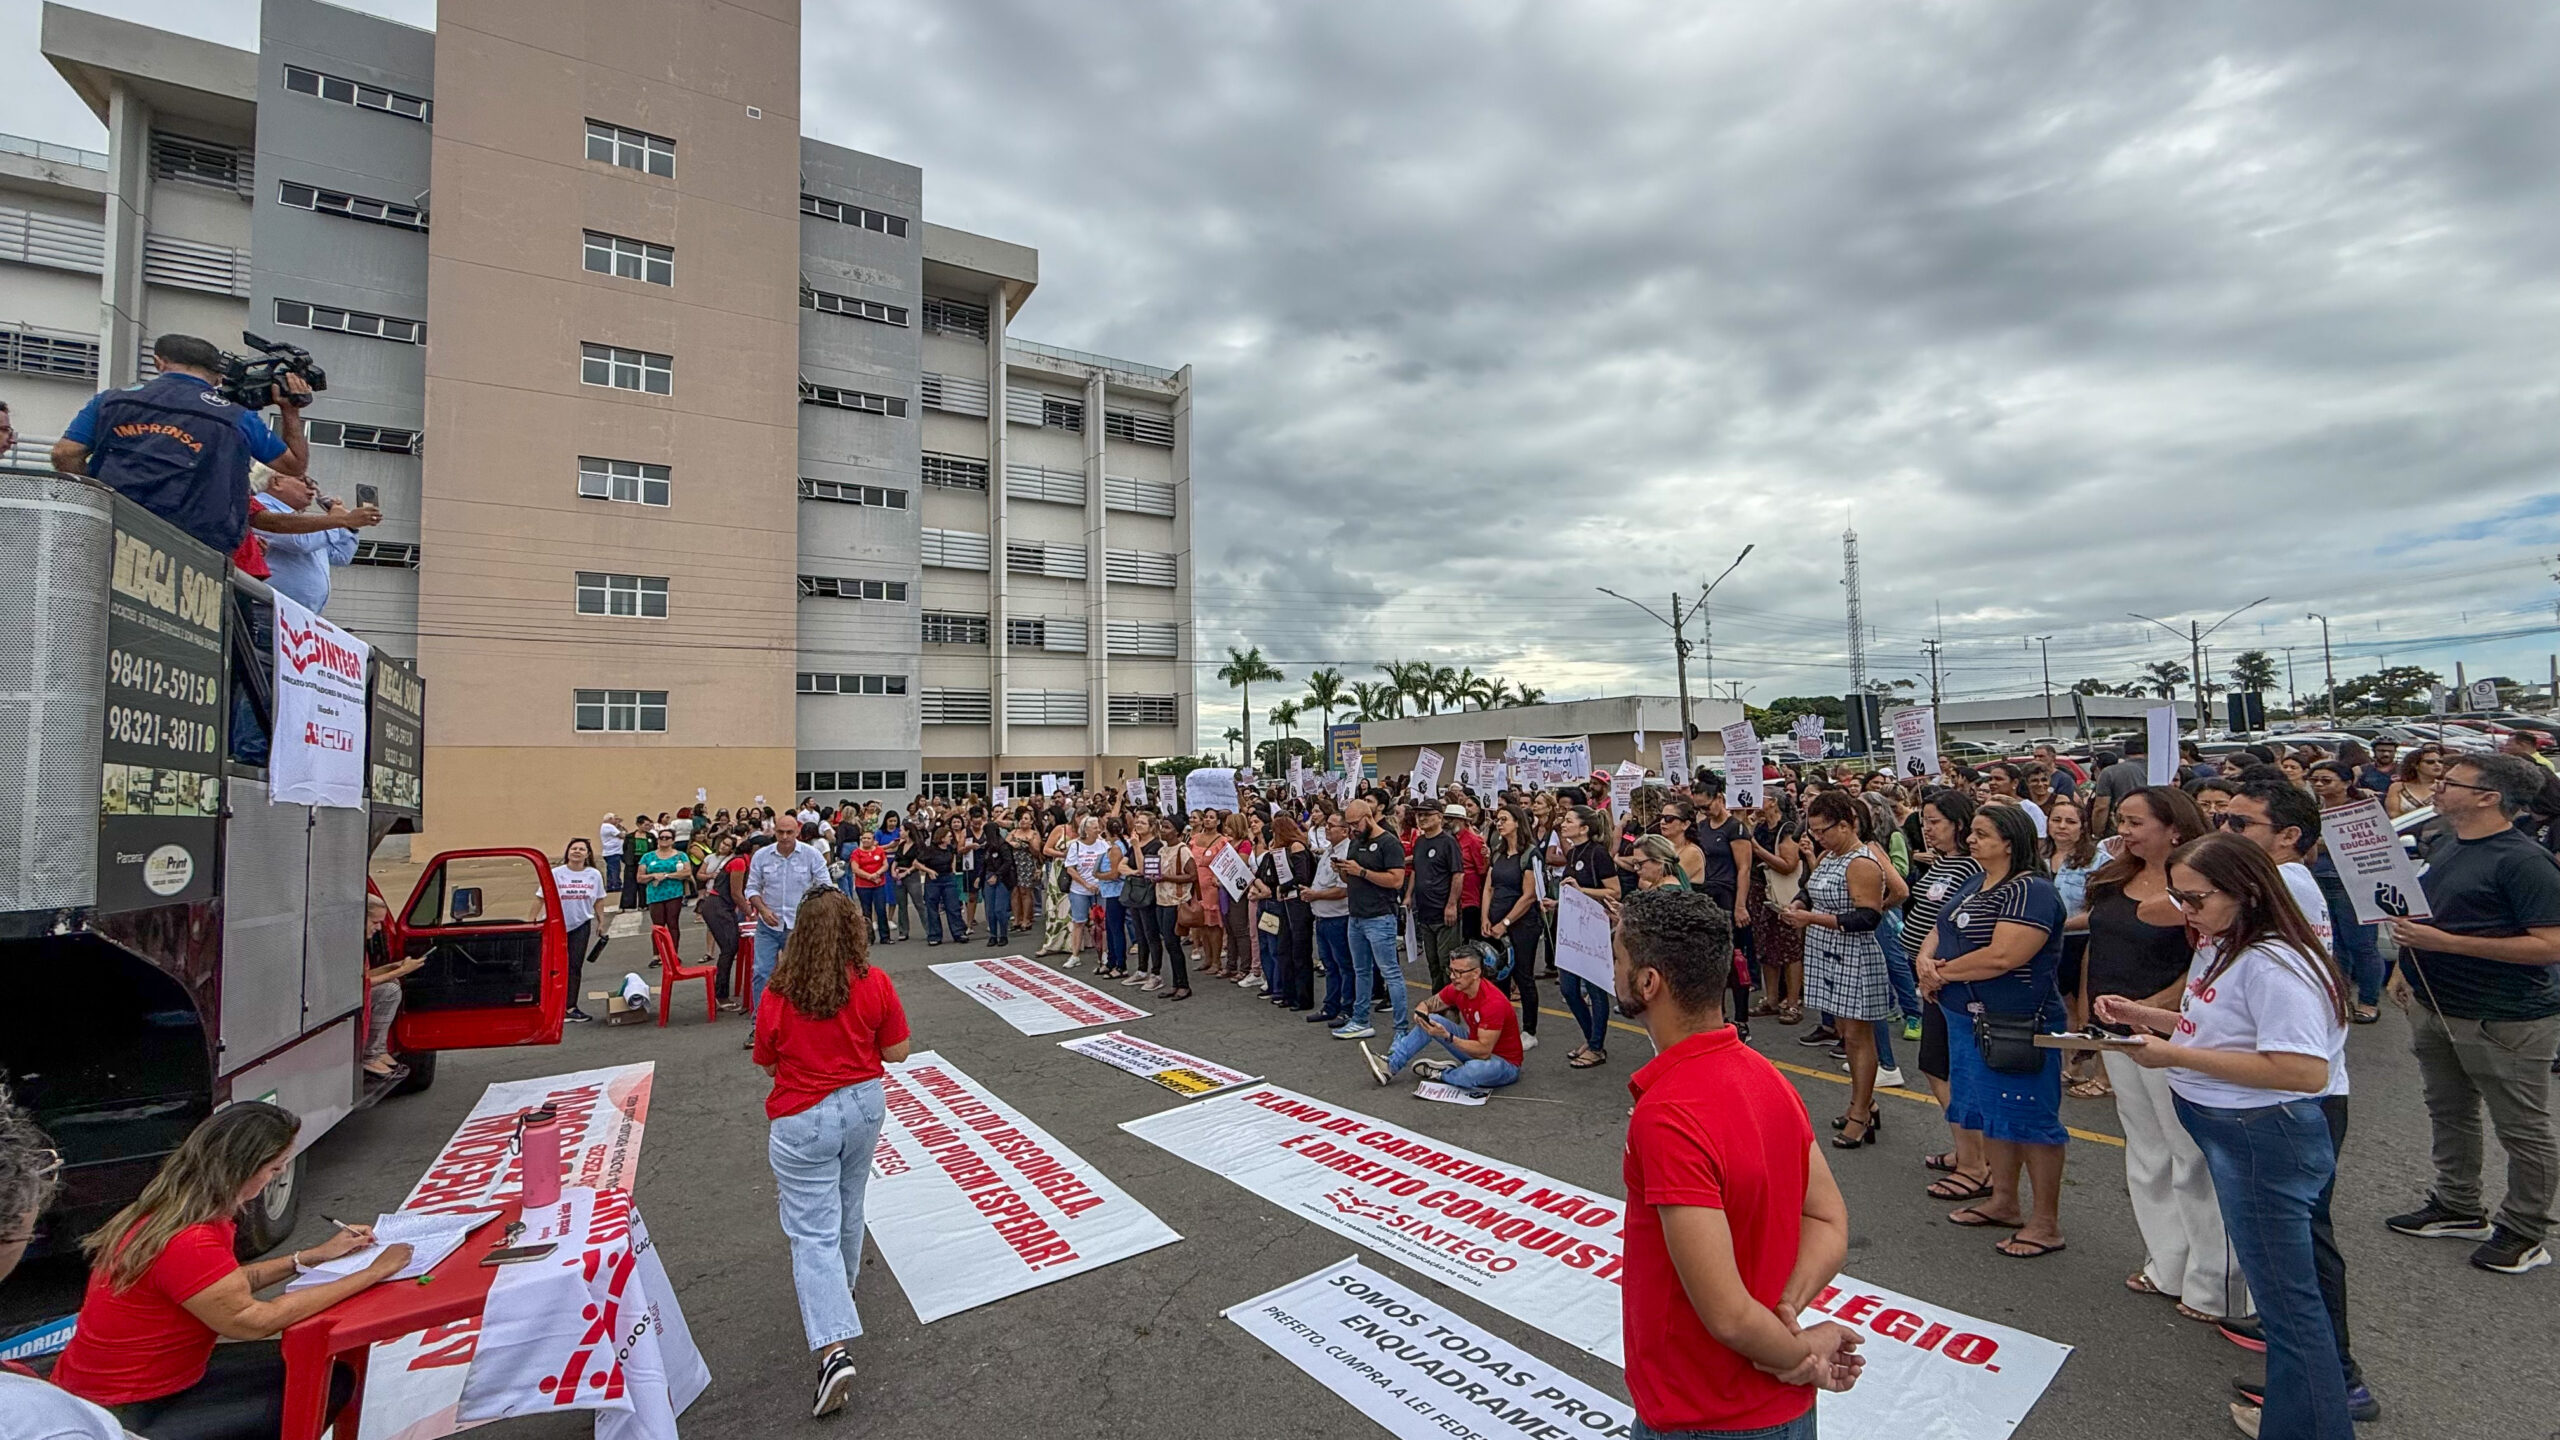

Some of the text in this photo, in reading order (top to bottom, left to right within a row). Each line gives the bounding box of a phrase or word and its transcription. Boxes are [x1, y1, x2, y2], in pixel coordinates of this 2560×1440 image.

[112, 423, 203, 453] IMPRENSA
[112, 528, 223, 632] MEGA SOM
[110, 649, 205, 706] 98412-5915
[314, 633, 362, 681] SINTEGO
[2478, 685, 2487, 693] E
[109, 705, 203, 753] 98321-3811
[1519, 742, 1563, 755] Agente
[2340, 835, 2388, 851] EDUCAÇÃO
[2346, 822, 2371, 833] LUTA
[2351, 830, 2375, 840] PELA
[885, 1088, 940, 1127] DIREITOS
[406, 1106, 533, 1210] REGIONAL
[906, 1066, 1105, 1219] CUMPRA A LEI DO DESCONGELA.
[909, 1123, 960, 1147] NÃO
[928, 1143, 1004, 1191] PODEM
[1279, 1134, 1314, 1149] É
[1299, 1142, 1430, 1198] DIREITO
[967, 1185, 1080, 1271] ESPERAR!
[1241, 1090, 2002, 1373] PLANO DE CARREIRA NÃO LÉGIO.
[1300, 1202, 1332, 1220] SINDICATO
[1330, 1215, 1345, 1225] DOS
[1343, 1222, 1396, 1249] TRABALHADORES
[1396, 1246, 1408, 1255] EM
[1407, 1251, 1446, 1271] EDUCAÇÃO
[1457, 1273, 1483, 1287] GOIÁS
[1376, 1224, 1398, 1237] GENTE
[1397, 1233, 1413, 1243] QUE
[1412, 1239, 1449, 1259] TRABALHA
[1455, 1259, 1497, 1280] EDUCAÇÃO
[1385, 1214, 1518, 1273] SINTEGO
[626, 1313, 651, 1347] DOS
[1328, 1274, 1431, 1329] SOMOS
[1424, 1325, 1537, 1388] TODAS
[1262, 1306, 1326, 1349] PREFEITO,
[1324, 1346, 1393, 1390] CUMPRA
[1387, 1387, 1404, 1400] A
[1403, 1396, 1427, 1414] LEI
